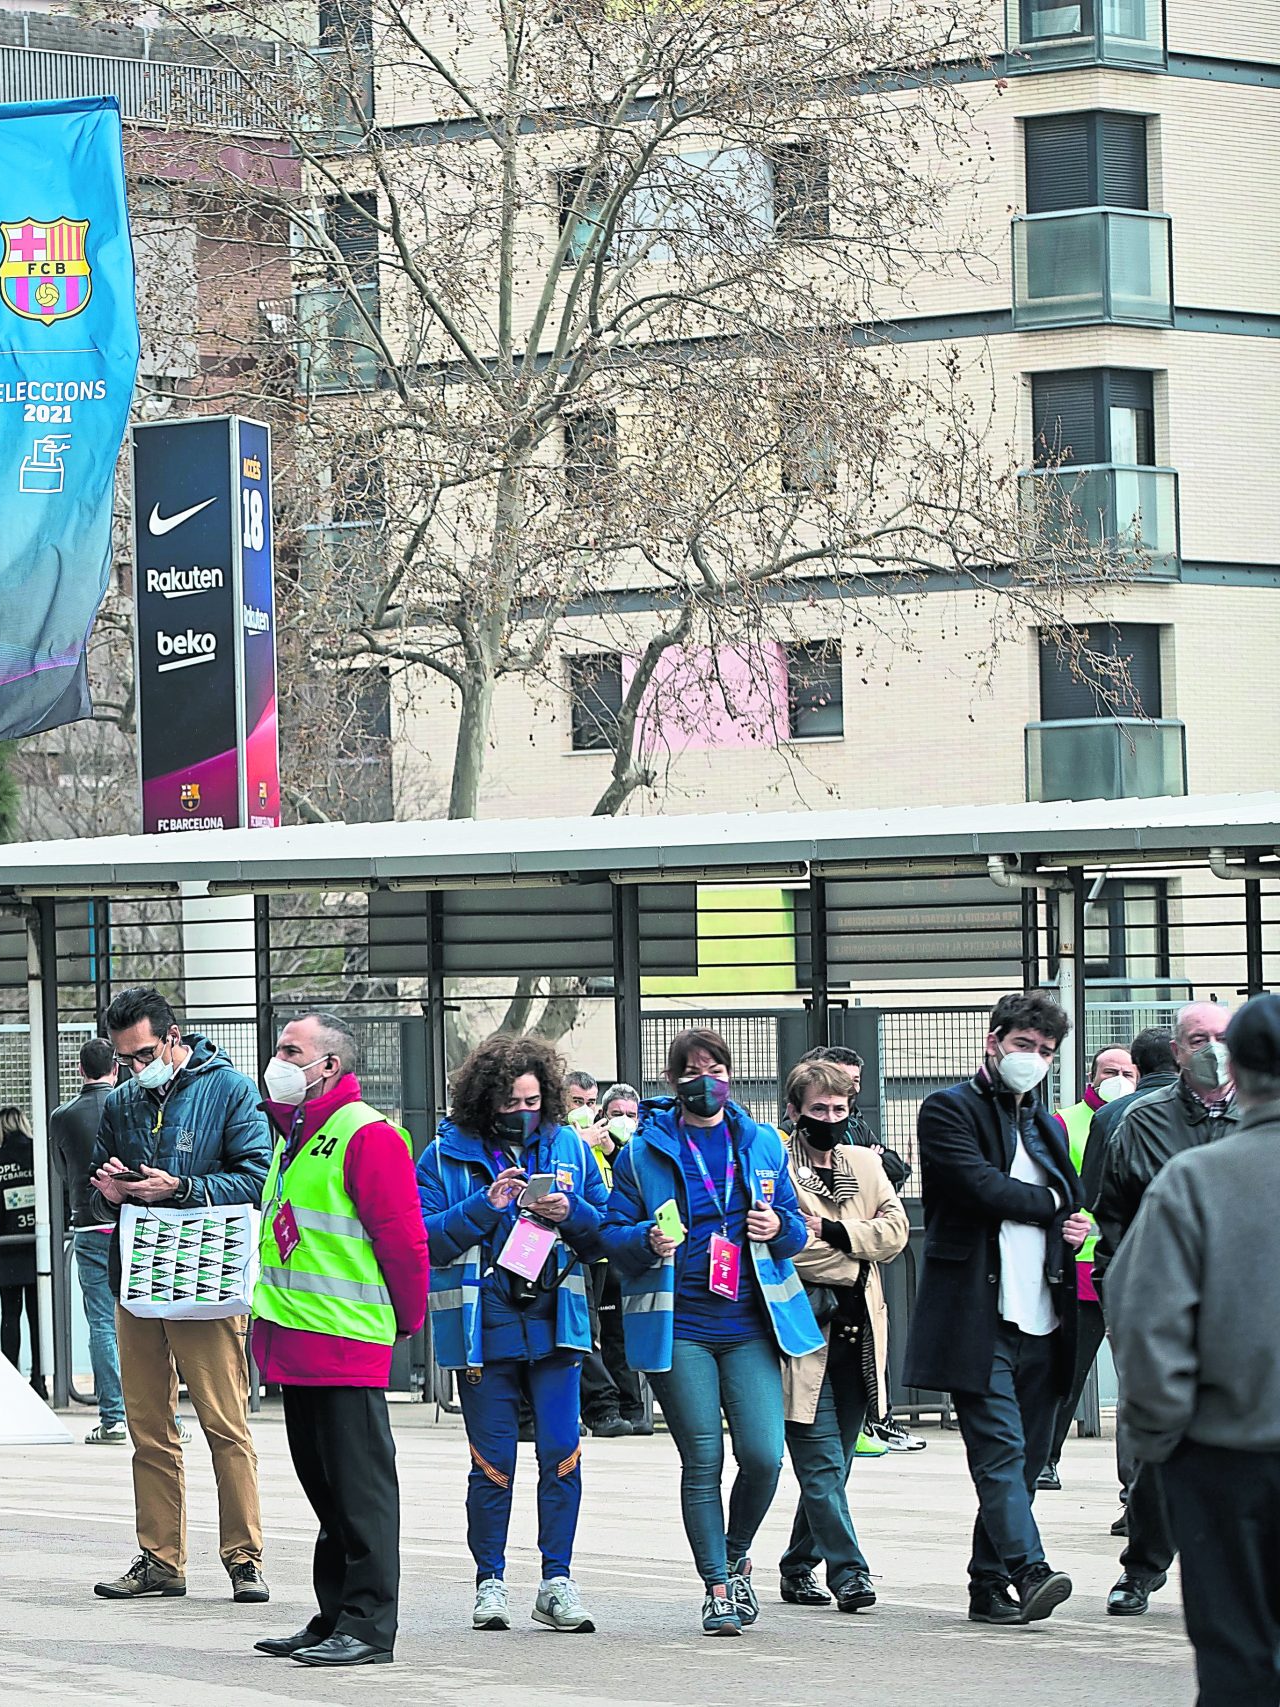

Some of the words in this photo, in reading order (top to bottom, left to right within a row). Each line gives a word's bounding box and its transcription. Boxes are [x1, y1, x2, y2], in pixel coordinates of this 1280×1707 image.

[28, 262, 66, 276] FCB
[23, 403, 72, 424] 2021
[242, 488, 264, 552] 18
[146, 566, 224, 592] Rakuten
[156, 629, 217, 656] beko
[157, 818, 169, 832] FC
[170, 816, 224, 831] BARCELONA
[310, 1134, 338, 1159] 24
[17, 1213, 36, 1228] 35
